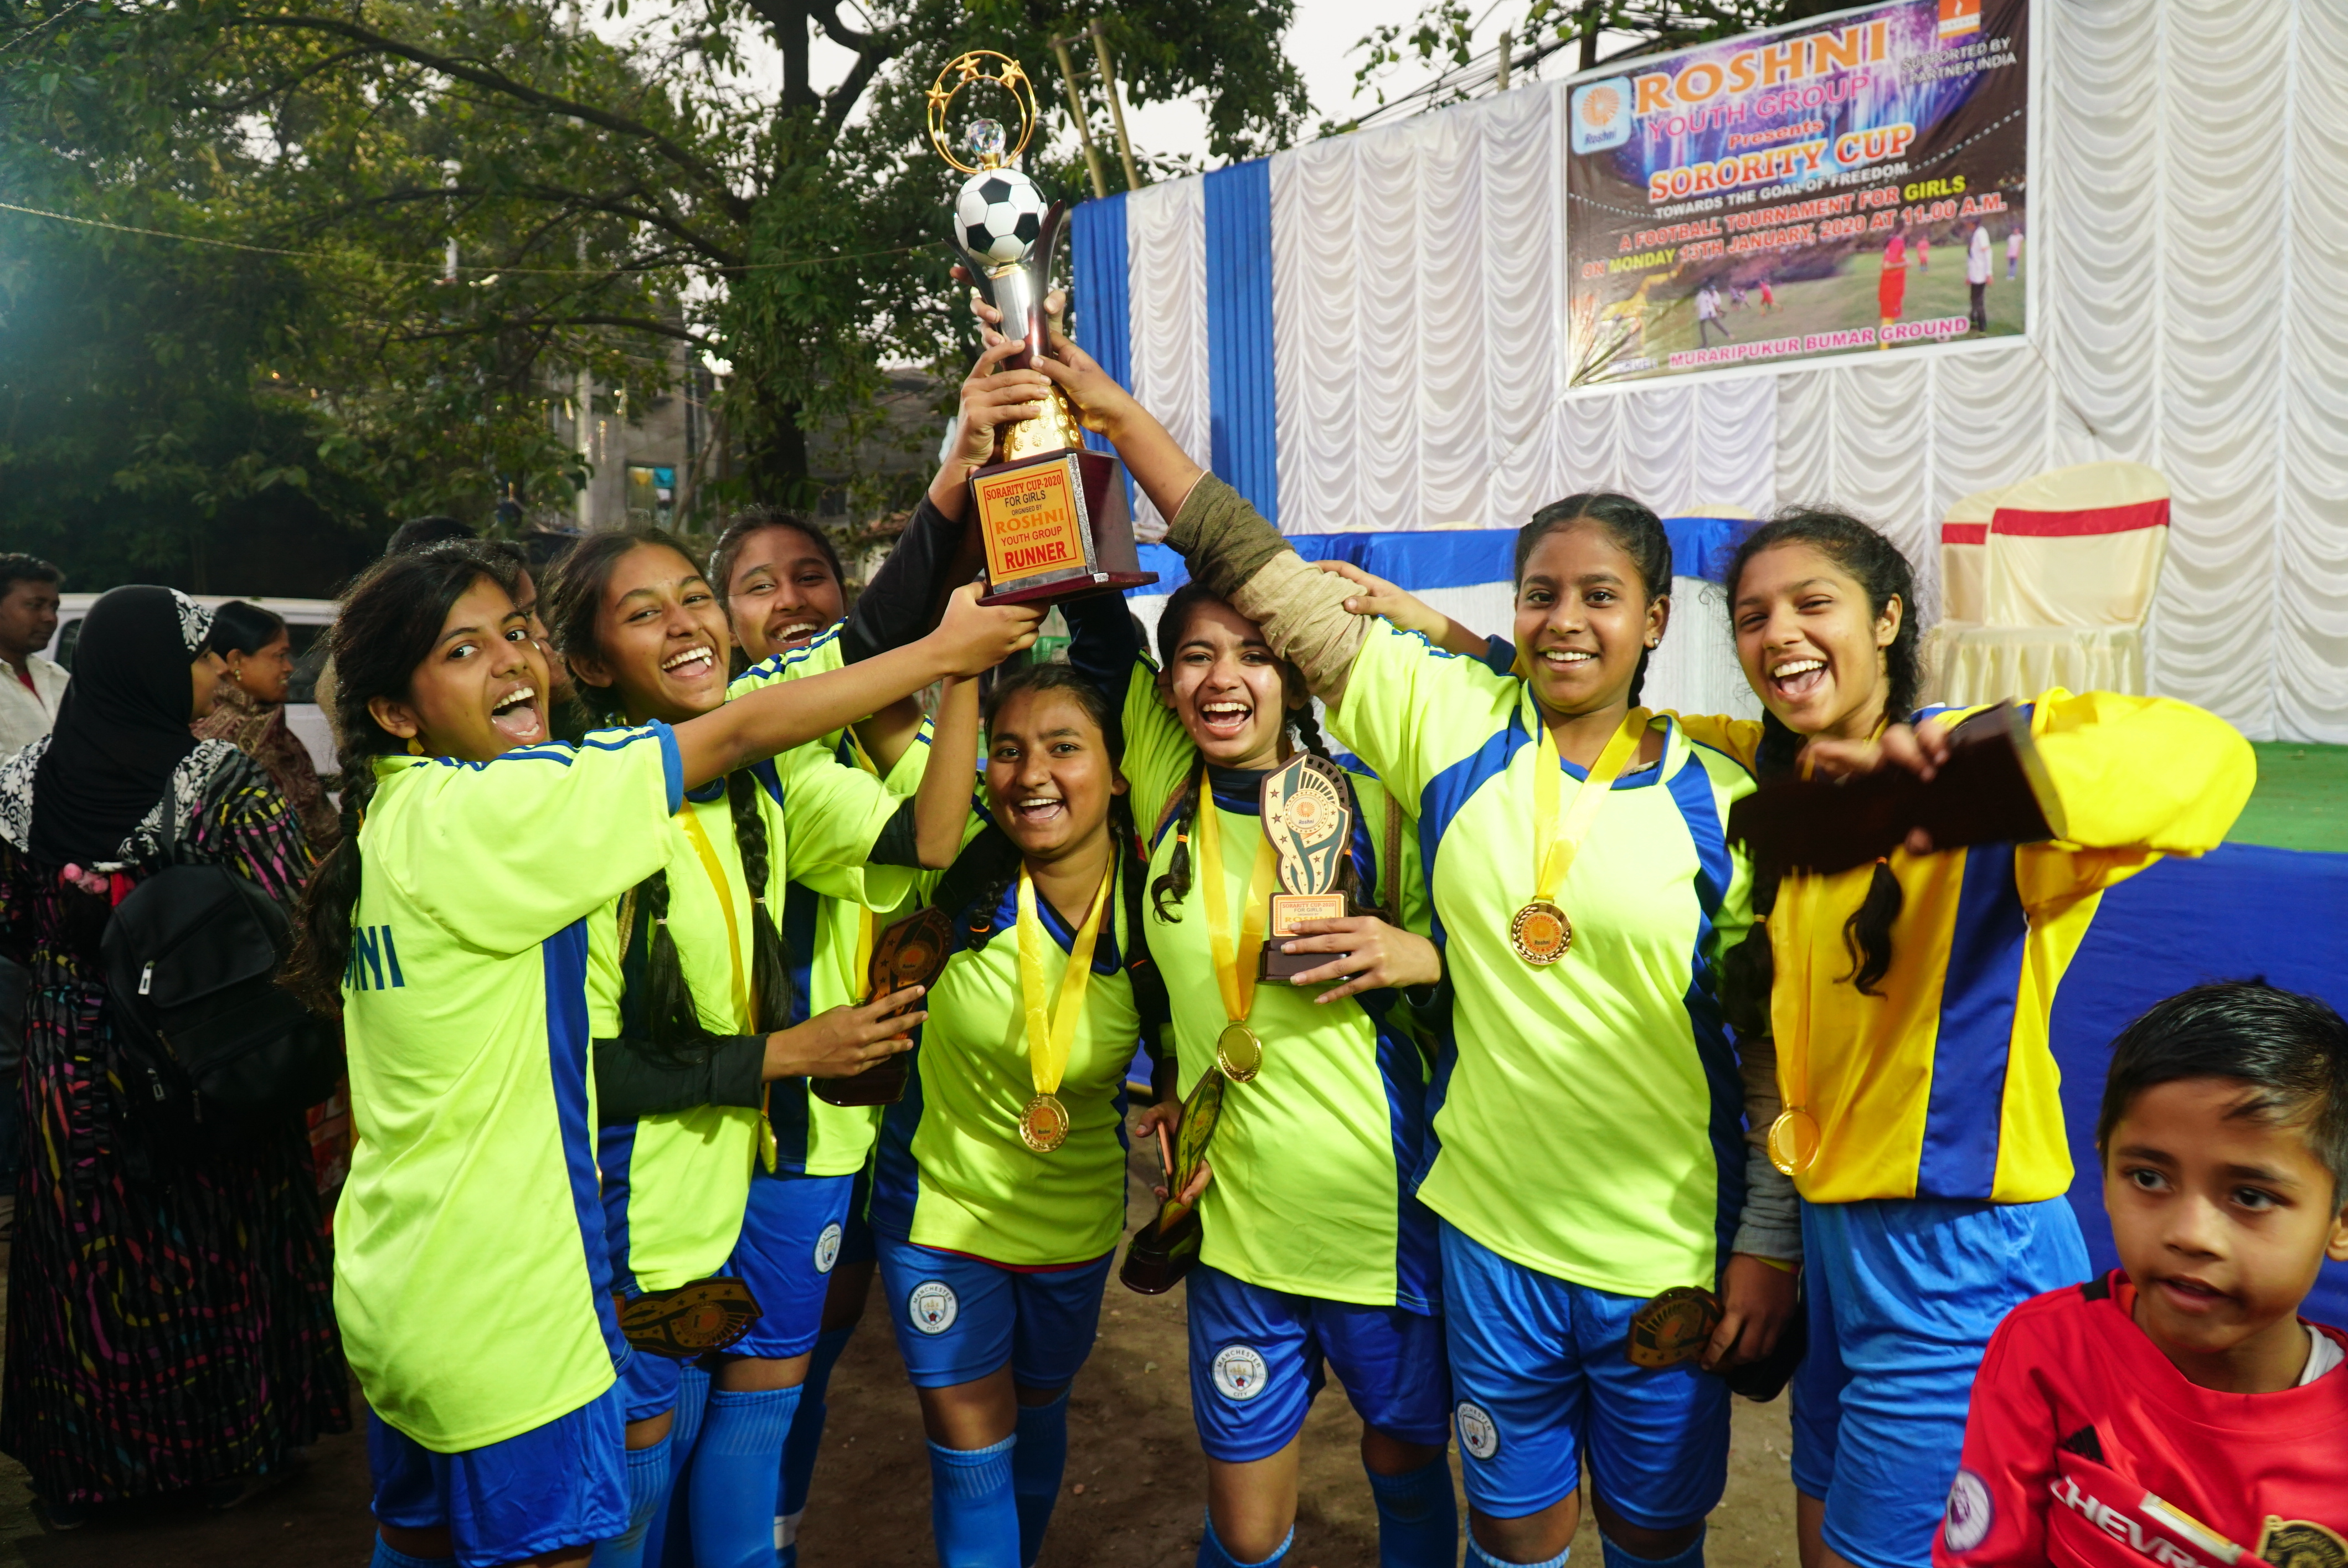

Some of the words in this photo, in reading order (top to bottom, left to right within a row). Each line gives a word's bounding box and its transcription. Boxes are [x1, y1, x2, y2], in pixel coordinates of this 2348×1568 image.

[1636, 20, 1886, 114] ROSHNI
[1902, 42, 1987, 70] SUPPORTED
[1990, 37, 2011, 52] BY
[1910, 61, 1975, 84] PARTNER
[1977, 51, 2017, 70] INDIA
[1648, 101, 1745, 141] YOUTH
[1757, 76, 1870, 117] GROUP
[1728, 119, 1825, 148] Presents
[1650, 140, 1827, 202] SORORITY
[1836, 123, 1915, 164] CUP
[1655, 196, 1723, 219] TOWARDS
[1727, 189, 1757, 205] THE
[1760, 182, 1800, 199] GOAL
[1805, 176, 1826, 192] OF
[1619, 234, 1633, 252] A
[1634, 217, 1723, 249] FOOTBALL
[1724, 192, 1855, 231] TOURNAMENT
[1858, 185, 1901, 210] FOR
[1903, 174, 1966, 201] GIRLS
[1582, 260, 1605, 278] ON
[1608, 248, 1677, 274] MONDAY
[1680, 238, 1725, 263] 13TH
[1727, 223, 1817, 253] JANUARY,
[1819, 214, 1867, 239] 2020
[1869, 209, 1898, 231] AT
[1900, 198, 1958, 225] 11.00
[1959, 192, 2008, 216] A.M.
[1669, 336, 1800, 369] MURARIPUKUR
[1804, 327, 1877, 352] BUMAR
[1879, 316, 1970, 342] GROUND
[986, 482, 1024, 500] SORARITY
[1026, 474, 1062, 492] CUP-2020
[1005, 495, 1021, 508] FOR
[1023, 489, 1046, 504] GIRLS
[995, 508, 1064, 534] ROSHNI
[1011, 506, 1035, 515] ORGNISED
[1001, 533, 1030, 546] YOUTH
[1032, 526, 1062, 540] GROUP
[1005, 541, 1067, 569] RUNNER
[1546, 937, 1559, 951] GIRLS
[913, 1286, 952, 1304] MANCHESTER
[1217, 1349, 1261, 1369] MANCHESTER
